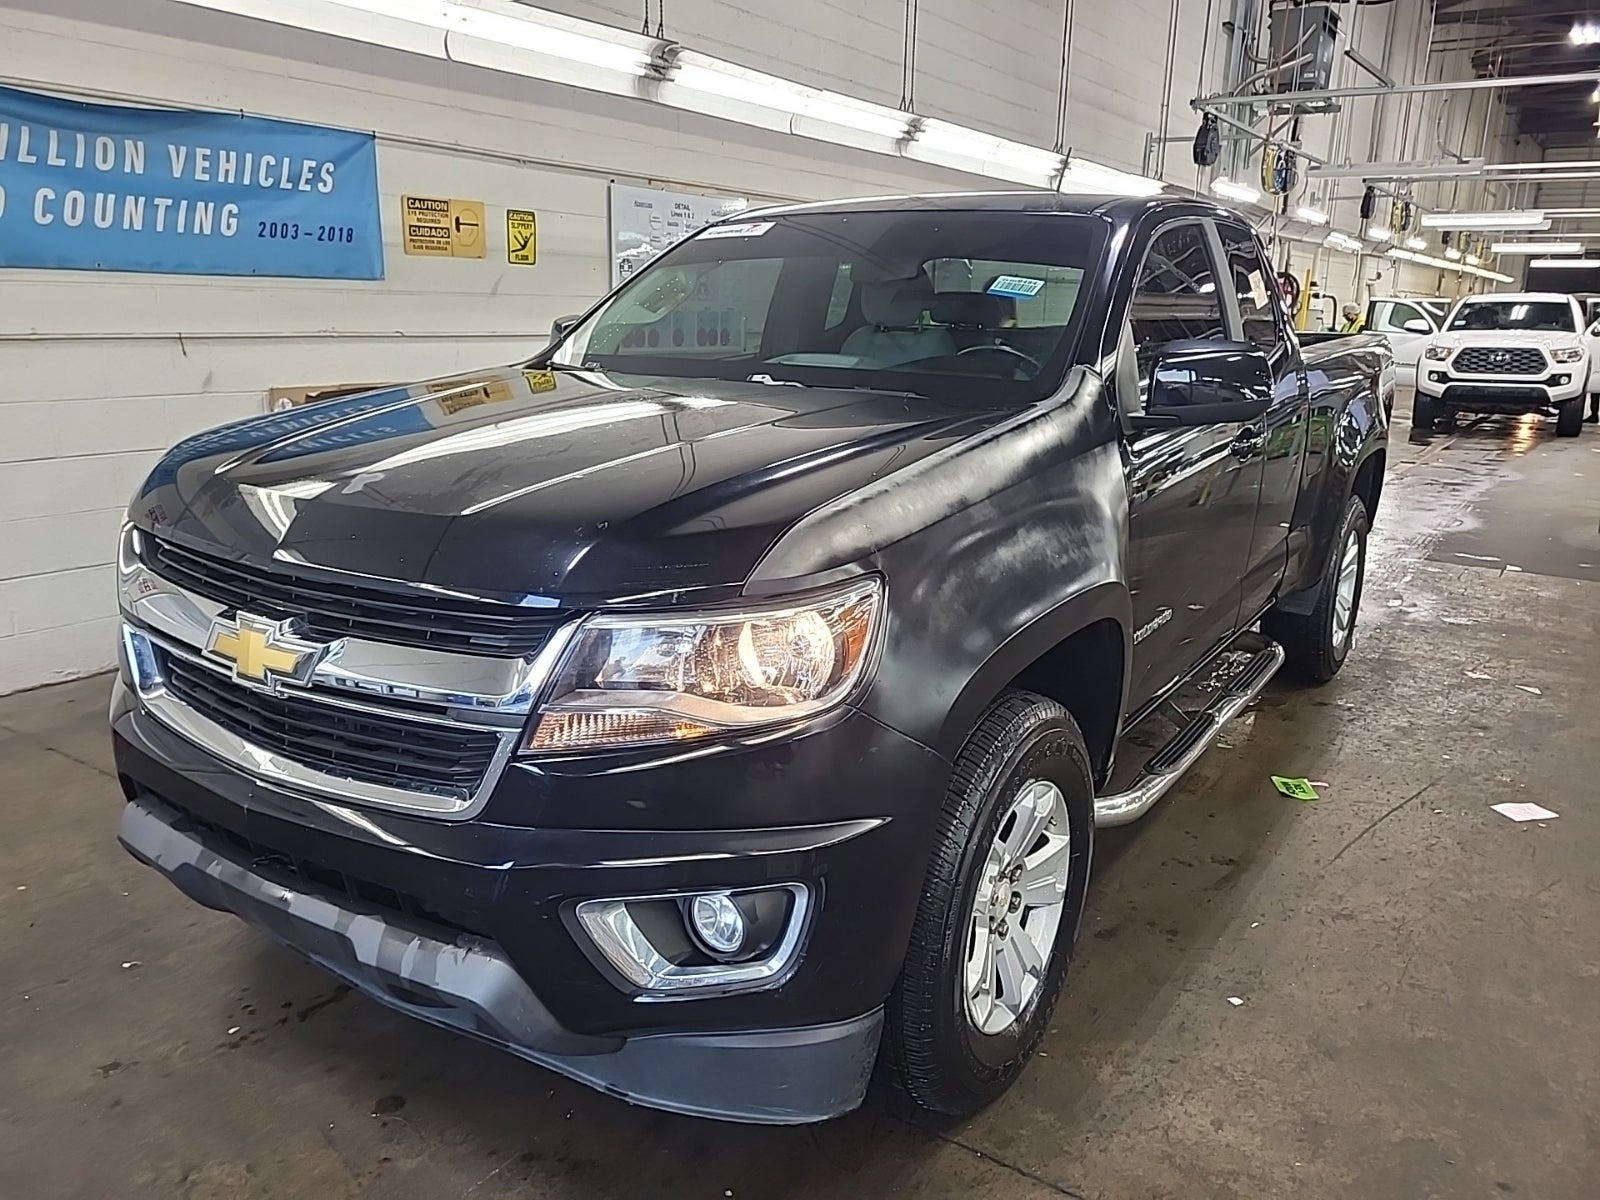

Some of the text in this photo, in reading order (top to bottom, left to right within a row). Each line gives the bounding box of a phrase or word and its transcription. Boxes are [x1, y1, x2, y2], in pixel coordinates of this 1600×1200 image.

[168, 144, 336, 193] VEHICLES
[407, 199, 449, 211] CAUTION
[674, 202, 691, 211] DETAIL
[33, 187, 239, 237] COUNTING
[509, 213, 533, 221] CAUTION
[511, 221, 533, 230] SLIPPERY
[410, 226, 449, 238] CUIDADO
[514, 253, 530, 262] FLOOR
